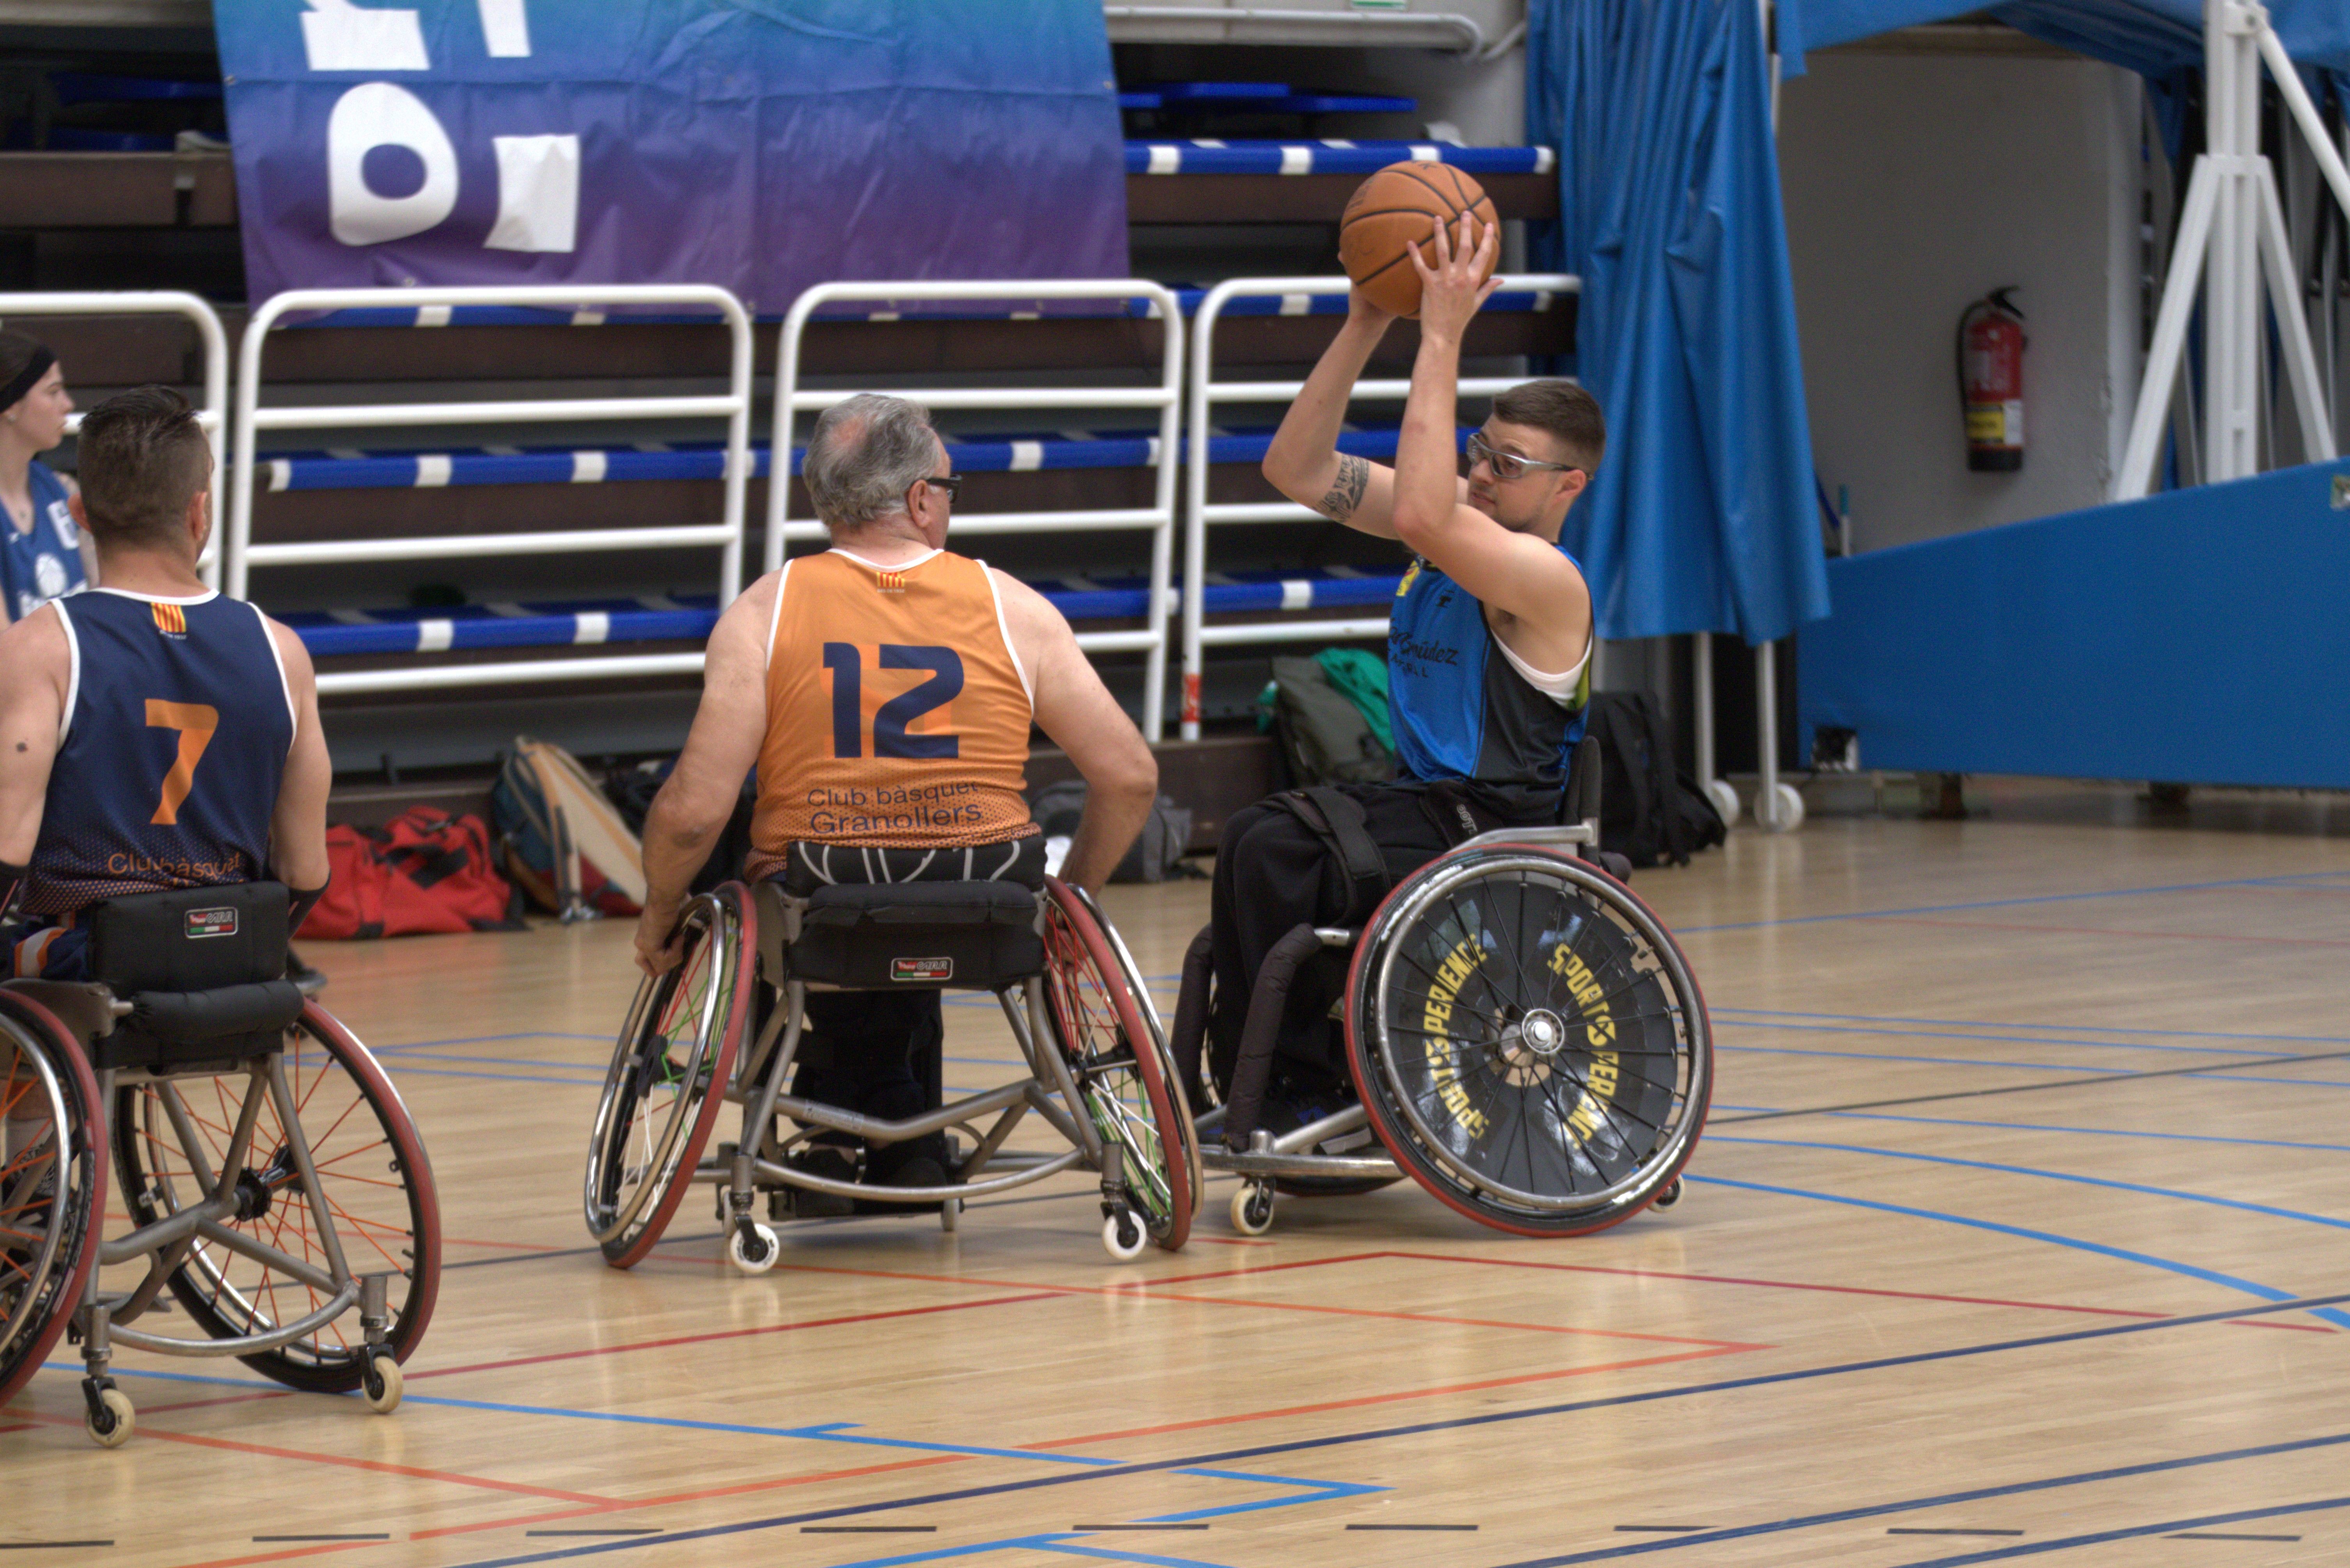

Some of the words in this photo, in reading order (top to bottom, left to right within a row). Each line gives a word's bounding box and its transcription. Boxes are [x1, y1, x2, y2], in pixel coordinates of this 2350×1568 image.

[823, 642, 964, 759] 12
[146, 699, 219, 825] 7
[807, 788, 866, 806] Club
[877, 783, 978, 805] bàsquet
[810, 804, 982, 834] Granollers
